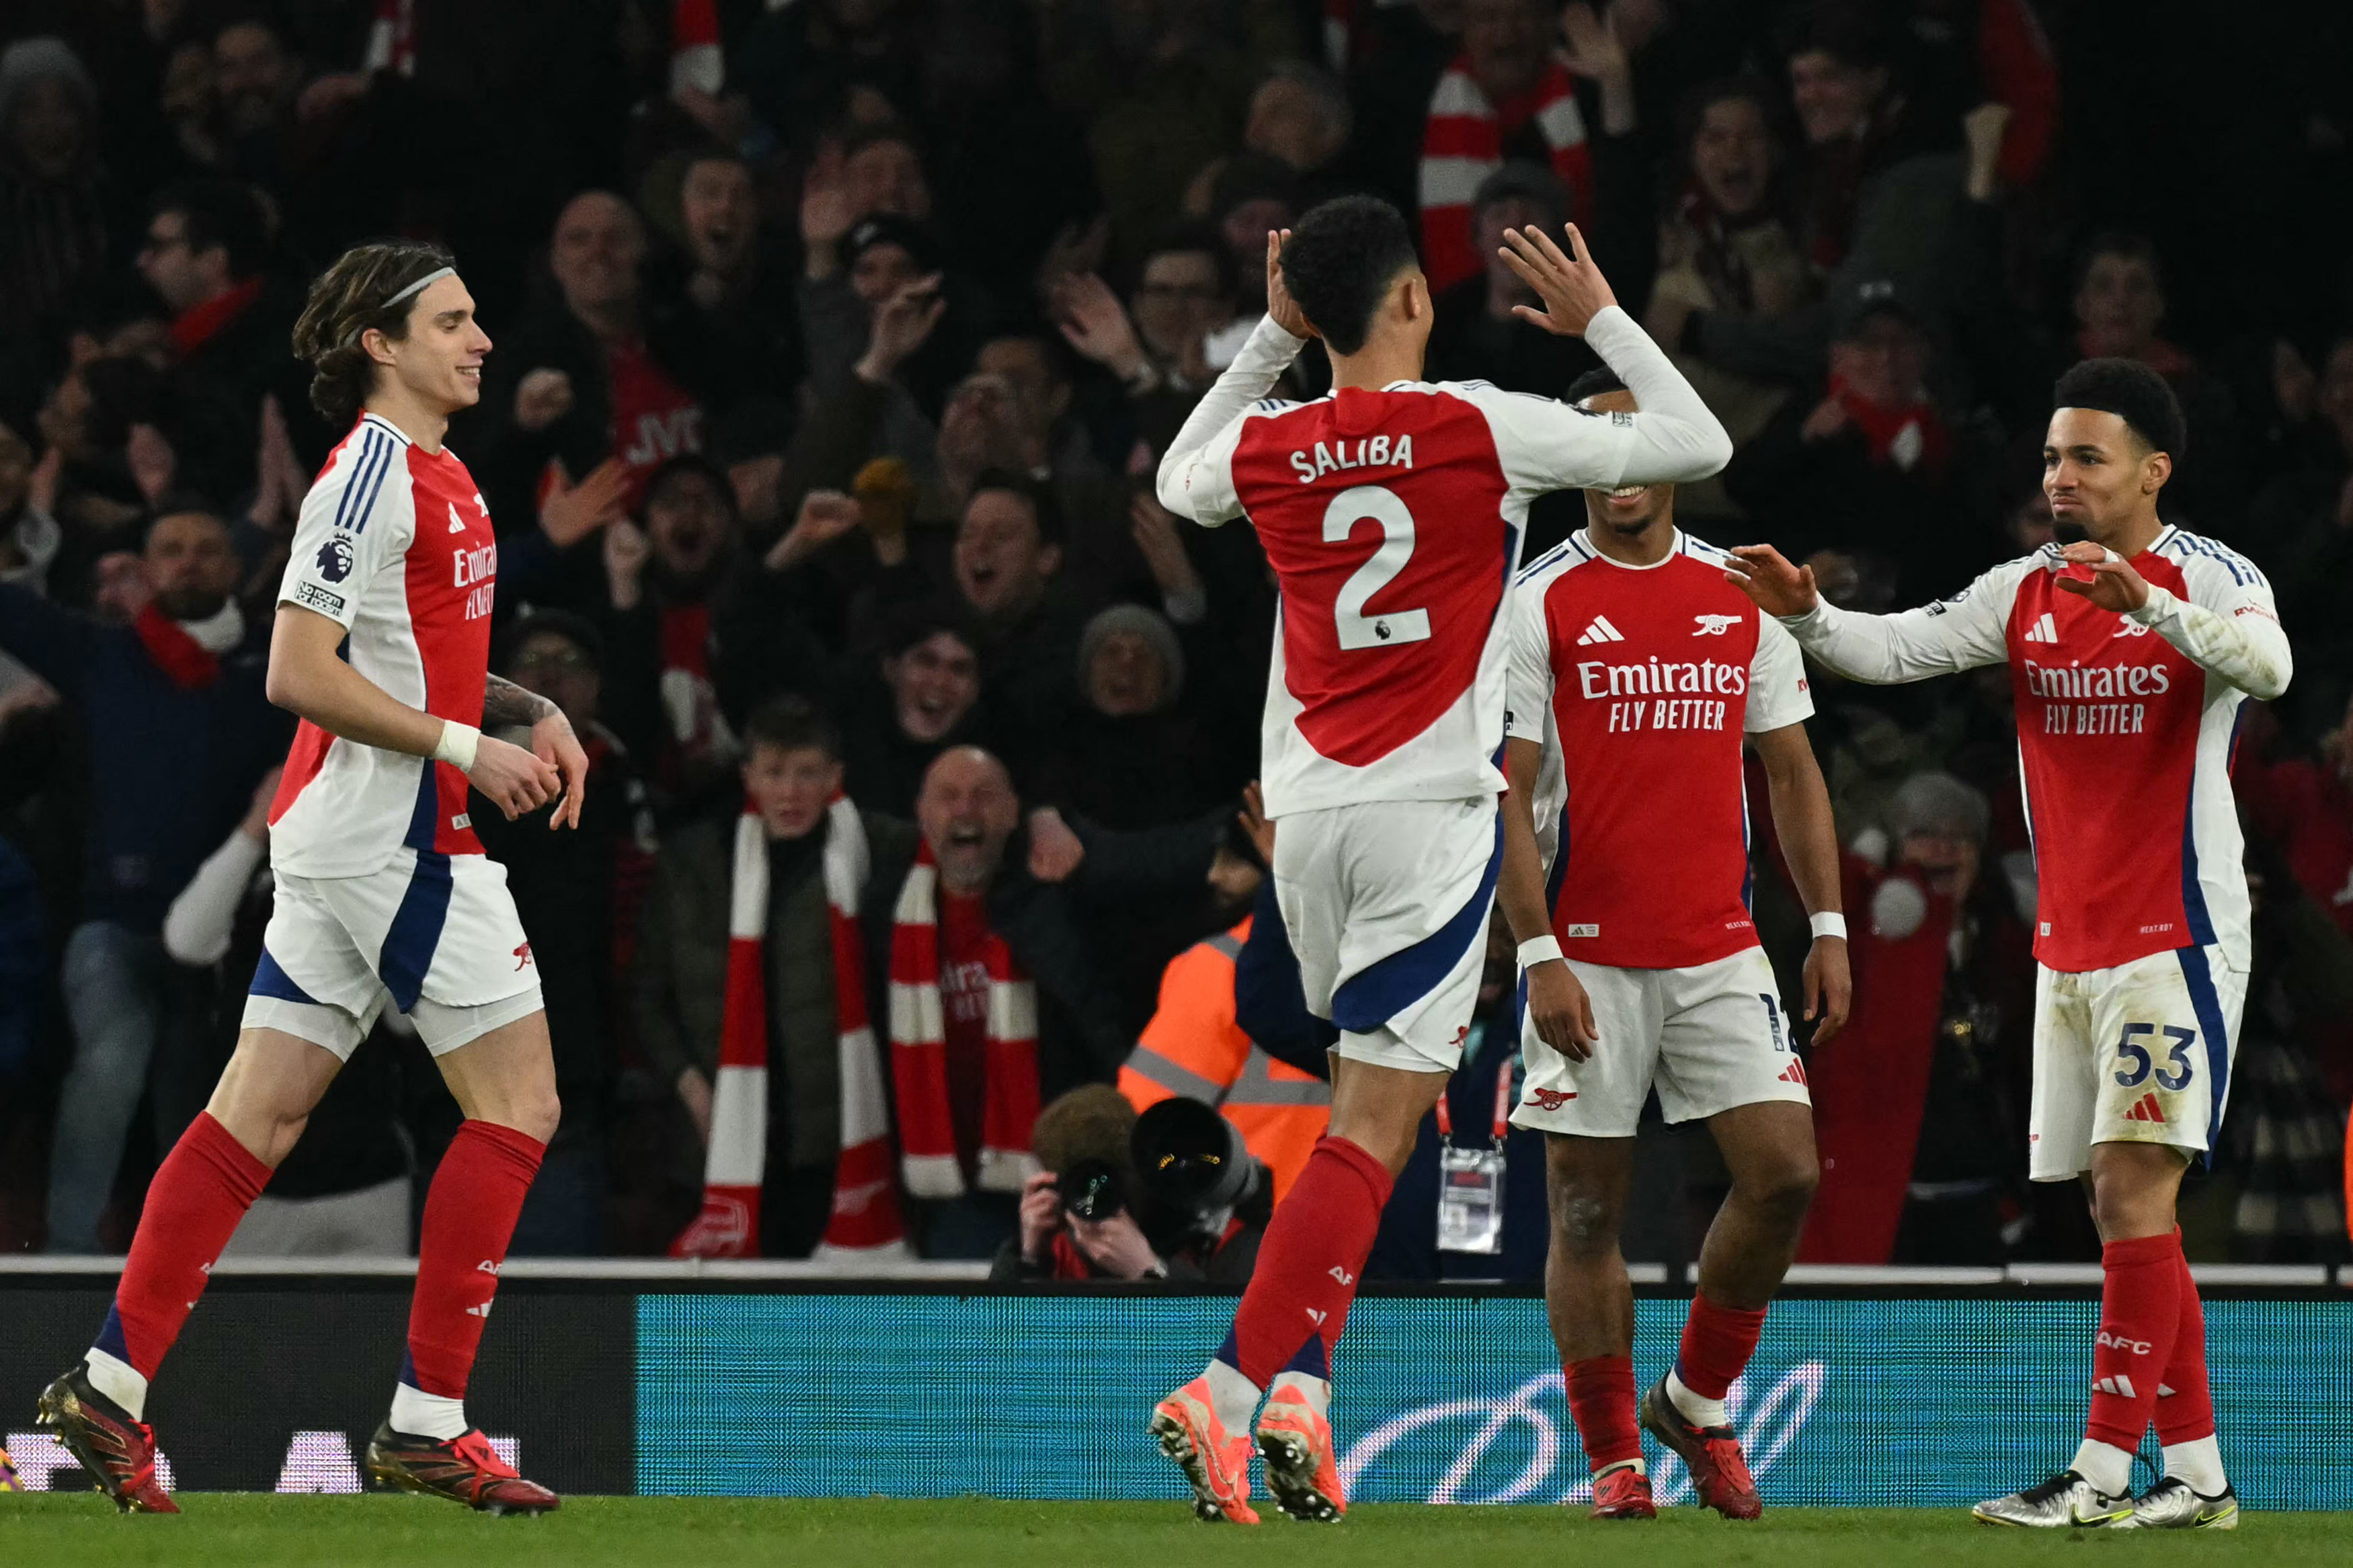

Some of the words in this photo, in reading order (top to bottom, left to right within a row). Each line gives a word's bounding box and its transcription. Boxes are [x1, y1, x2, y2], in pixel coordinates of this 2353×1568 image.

[1290, 434, 1413, 484] SALIBA
[1322, 485, 1431, 651] 2
[296, 581, 313, 594] No
[313, 589, 342, 607] room
[1577, 655, 1745, 699] Emirates
[2025, 659, 2169, 698] Emirates
[1609, 702, 1646, 733] FLY
[1652, 700, 1726, 731] BETTER
[2045, 704, 2070, 735] FLY
[2076, 704, 2145, 735] BETTER
[1759, 993, 1800, 1053] 1
[2114, 1023, 2196, 1091] 53
[2096, 1331, 2151, 1355] AFC
